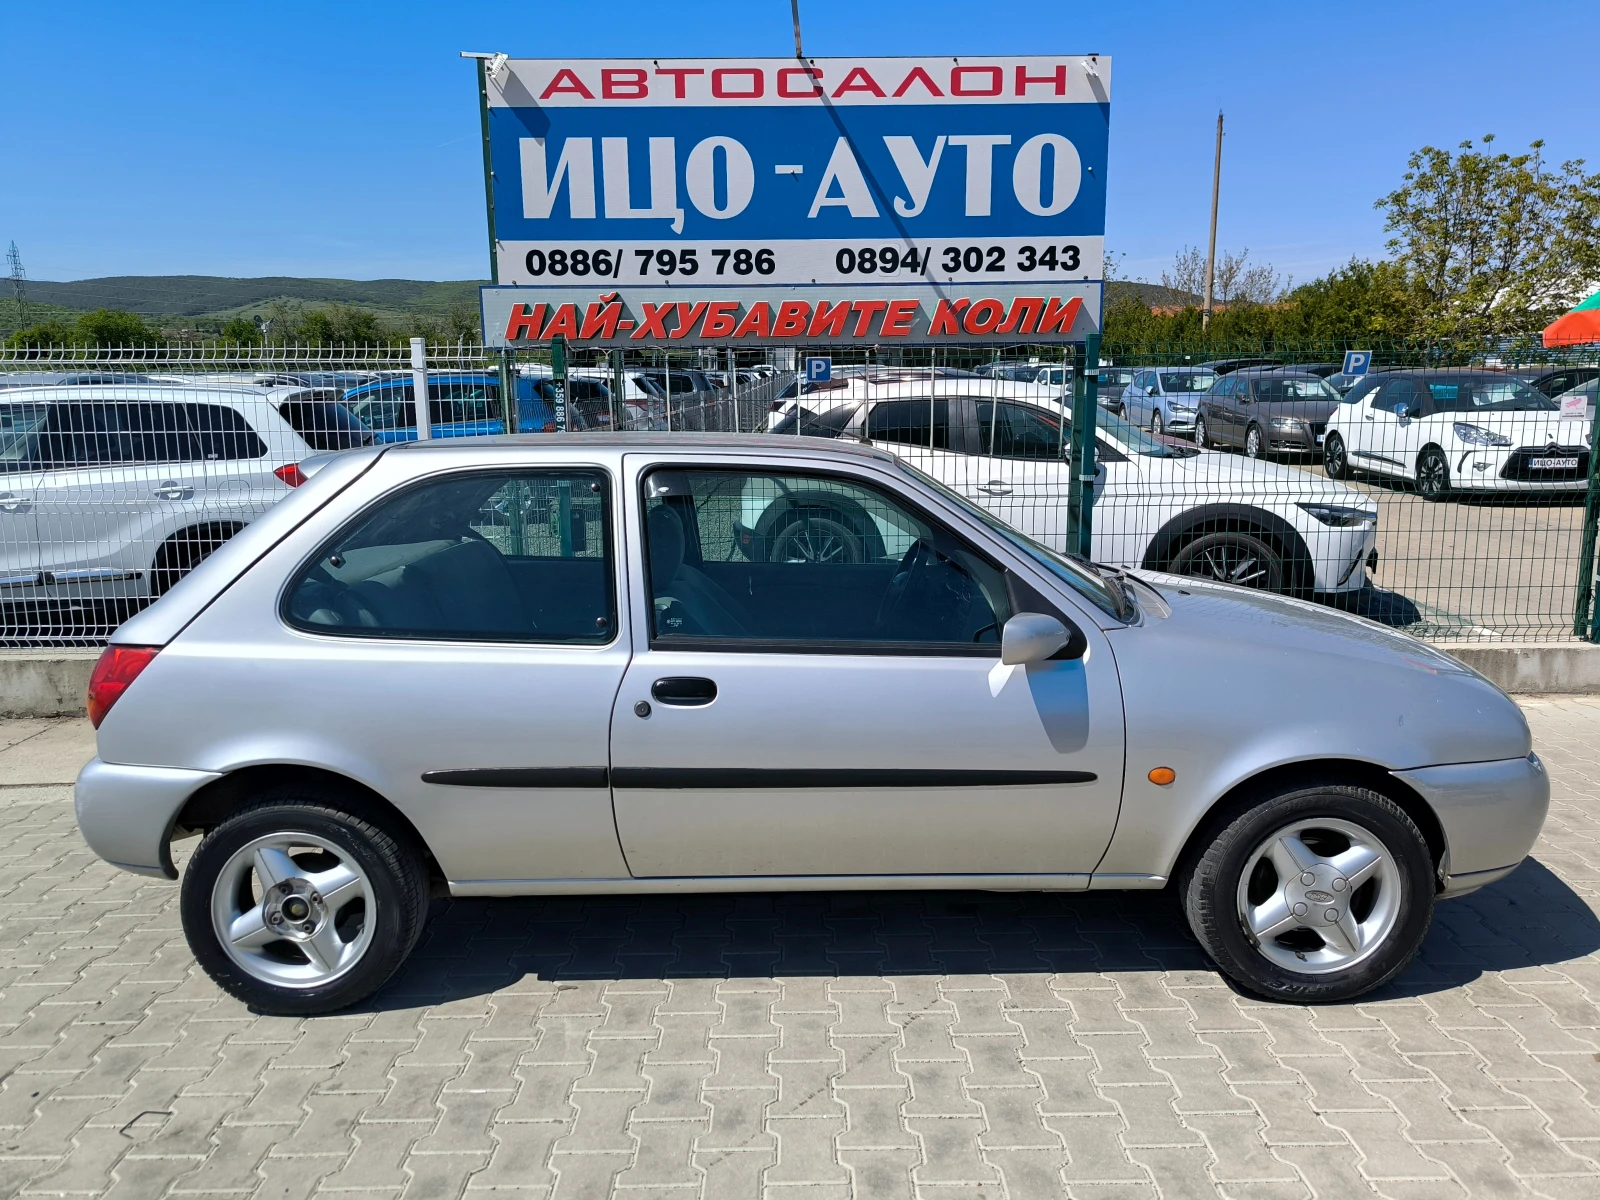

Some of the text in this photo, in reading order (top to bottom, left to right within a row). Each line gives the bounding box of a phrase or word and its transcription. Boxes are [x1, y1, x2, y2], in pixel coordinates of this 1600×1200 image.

[538, 65, 1067, 100] АВТОСАЛОН
[525, 248, 776, 279] 0886/ 795 786
[835, 244, 1081, 276] 0894/ 302 343
[504, 291, 1084, 340] НАЙ-ХУБАВИТЕ КОЛИ
[811, 360, 826, 379] P
[1347, 353, 1366, 373] P
[555, 381, 565, 404] +359
[555, 405, 566, 423] 886
